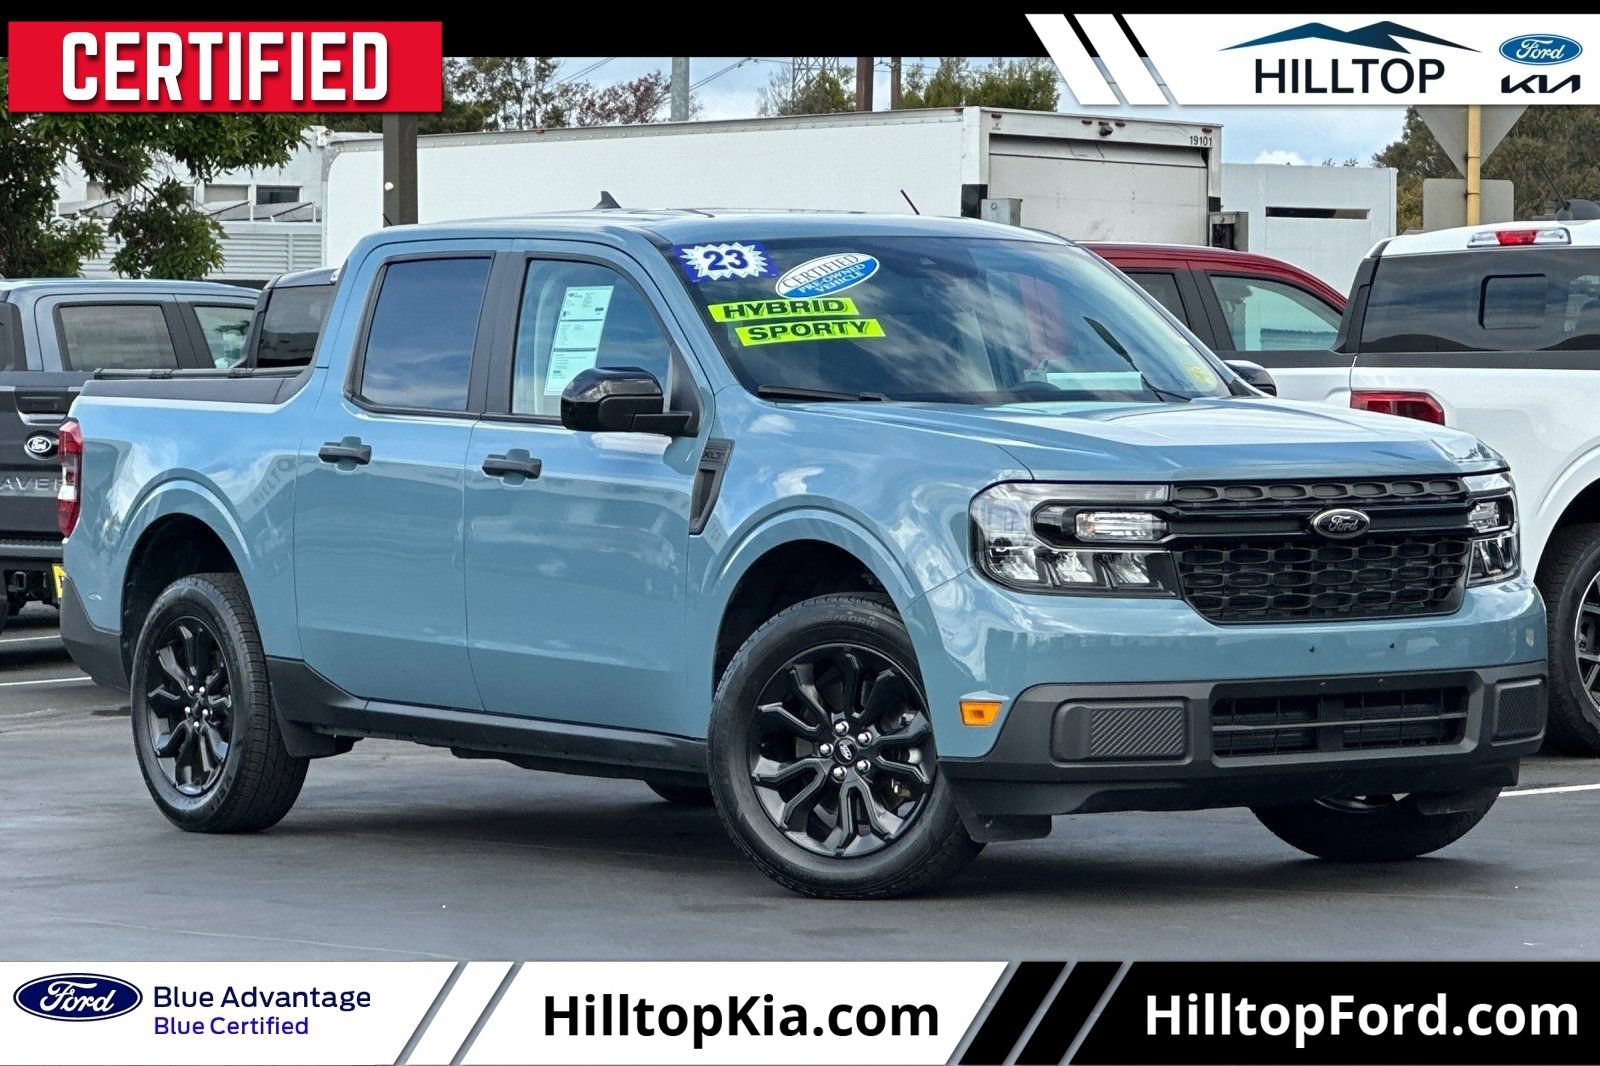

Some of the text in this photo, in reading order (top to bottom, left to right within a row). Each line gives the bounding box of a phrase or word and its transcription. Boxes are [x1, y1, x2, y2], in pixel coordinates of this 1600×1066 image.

[1189, 135, 1213, 146] 19101
[703, 250, 749, 271] 23
[782, 254, 859, 289] CERTIFIED
[798, 263, 866, 294] PRE-OWNED
[814, 271, 866, 294] VEHICLE
[723, 299, 847, 319] HYBRID
[747, 320, 867, 341] SPORTY
[702, 450, 726, 459] XLT
[1328, 514, 1359, 532] Ford
